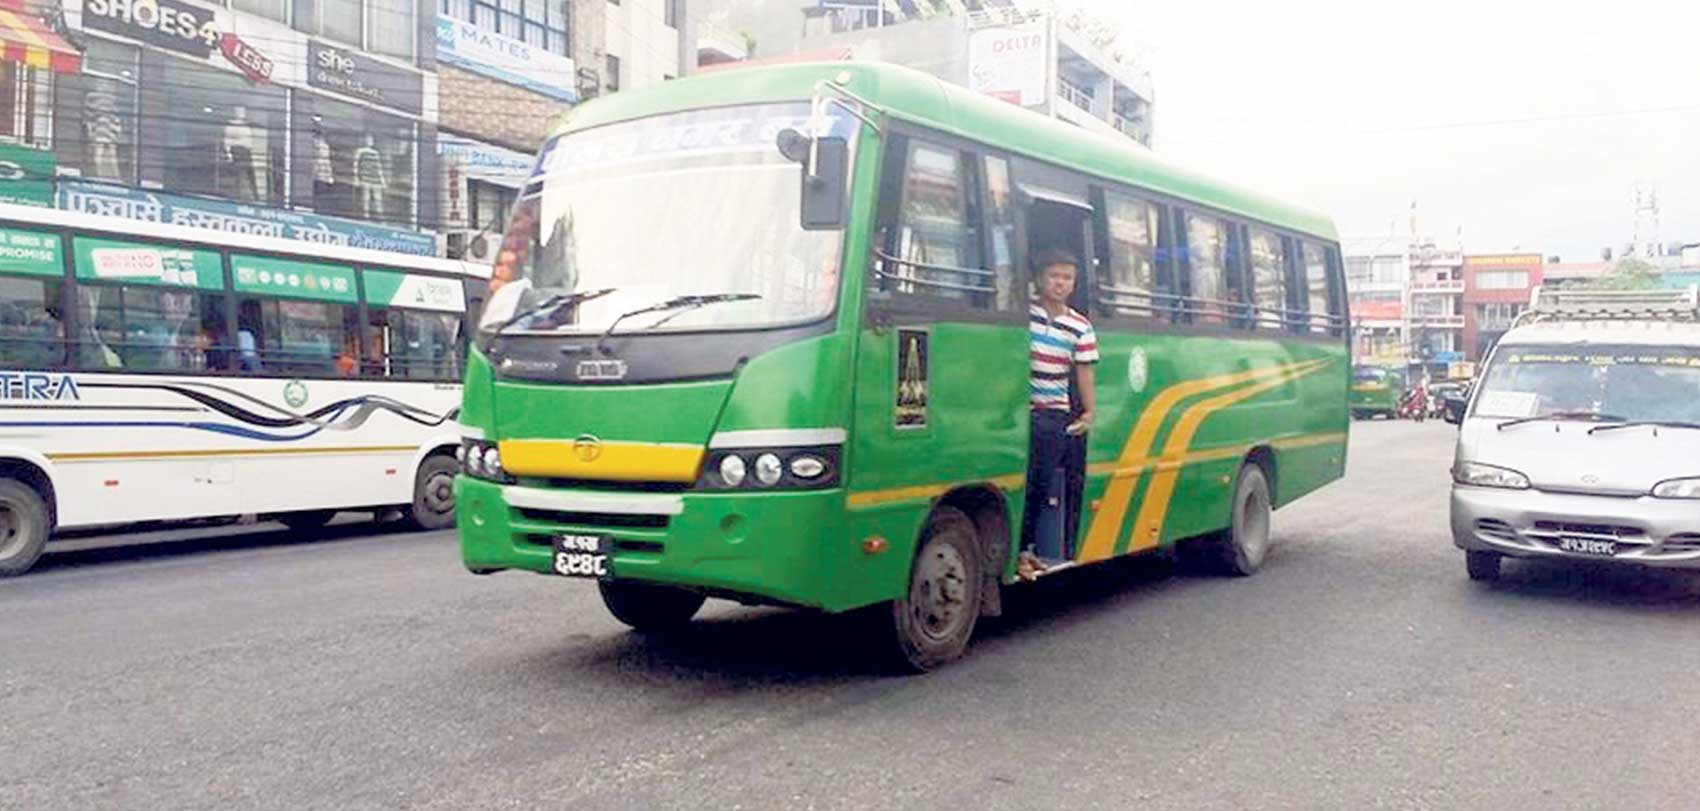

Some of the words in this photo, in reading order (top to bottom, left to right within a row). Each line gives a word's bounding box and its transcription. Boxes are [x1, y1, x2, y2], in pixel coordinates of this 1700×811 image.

[461, 26, 531, 60] MATES
[992, 34, 1041, 53] DELTA
[232, 43, 272, 78] LESS
[317, 48, 355, 74] she
